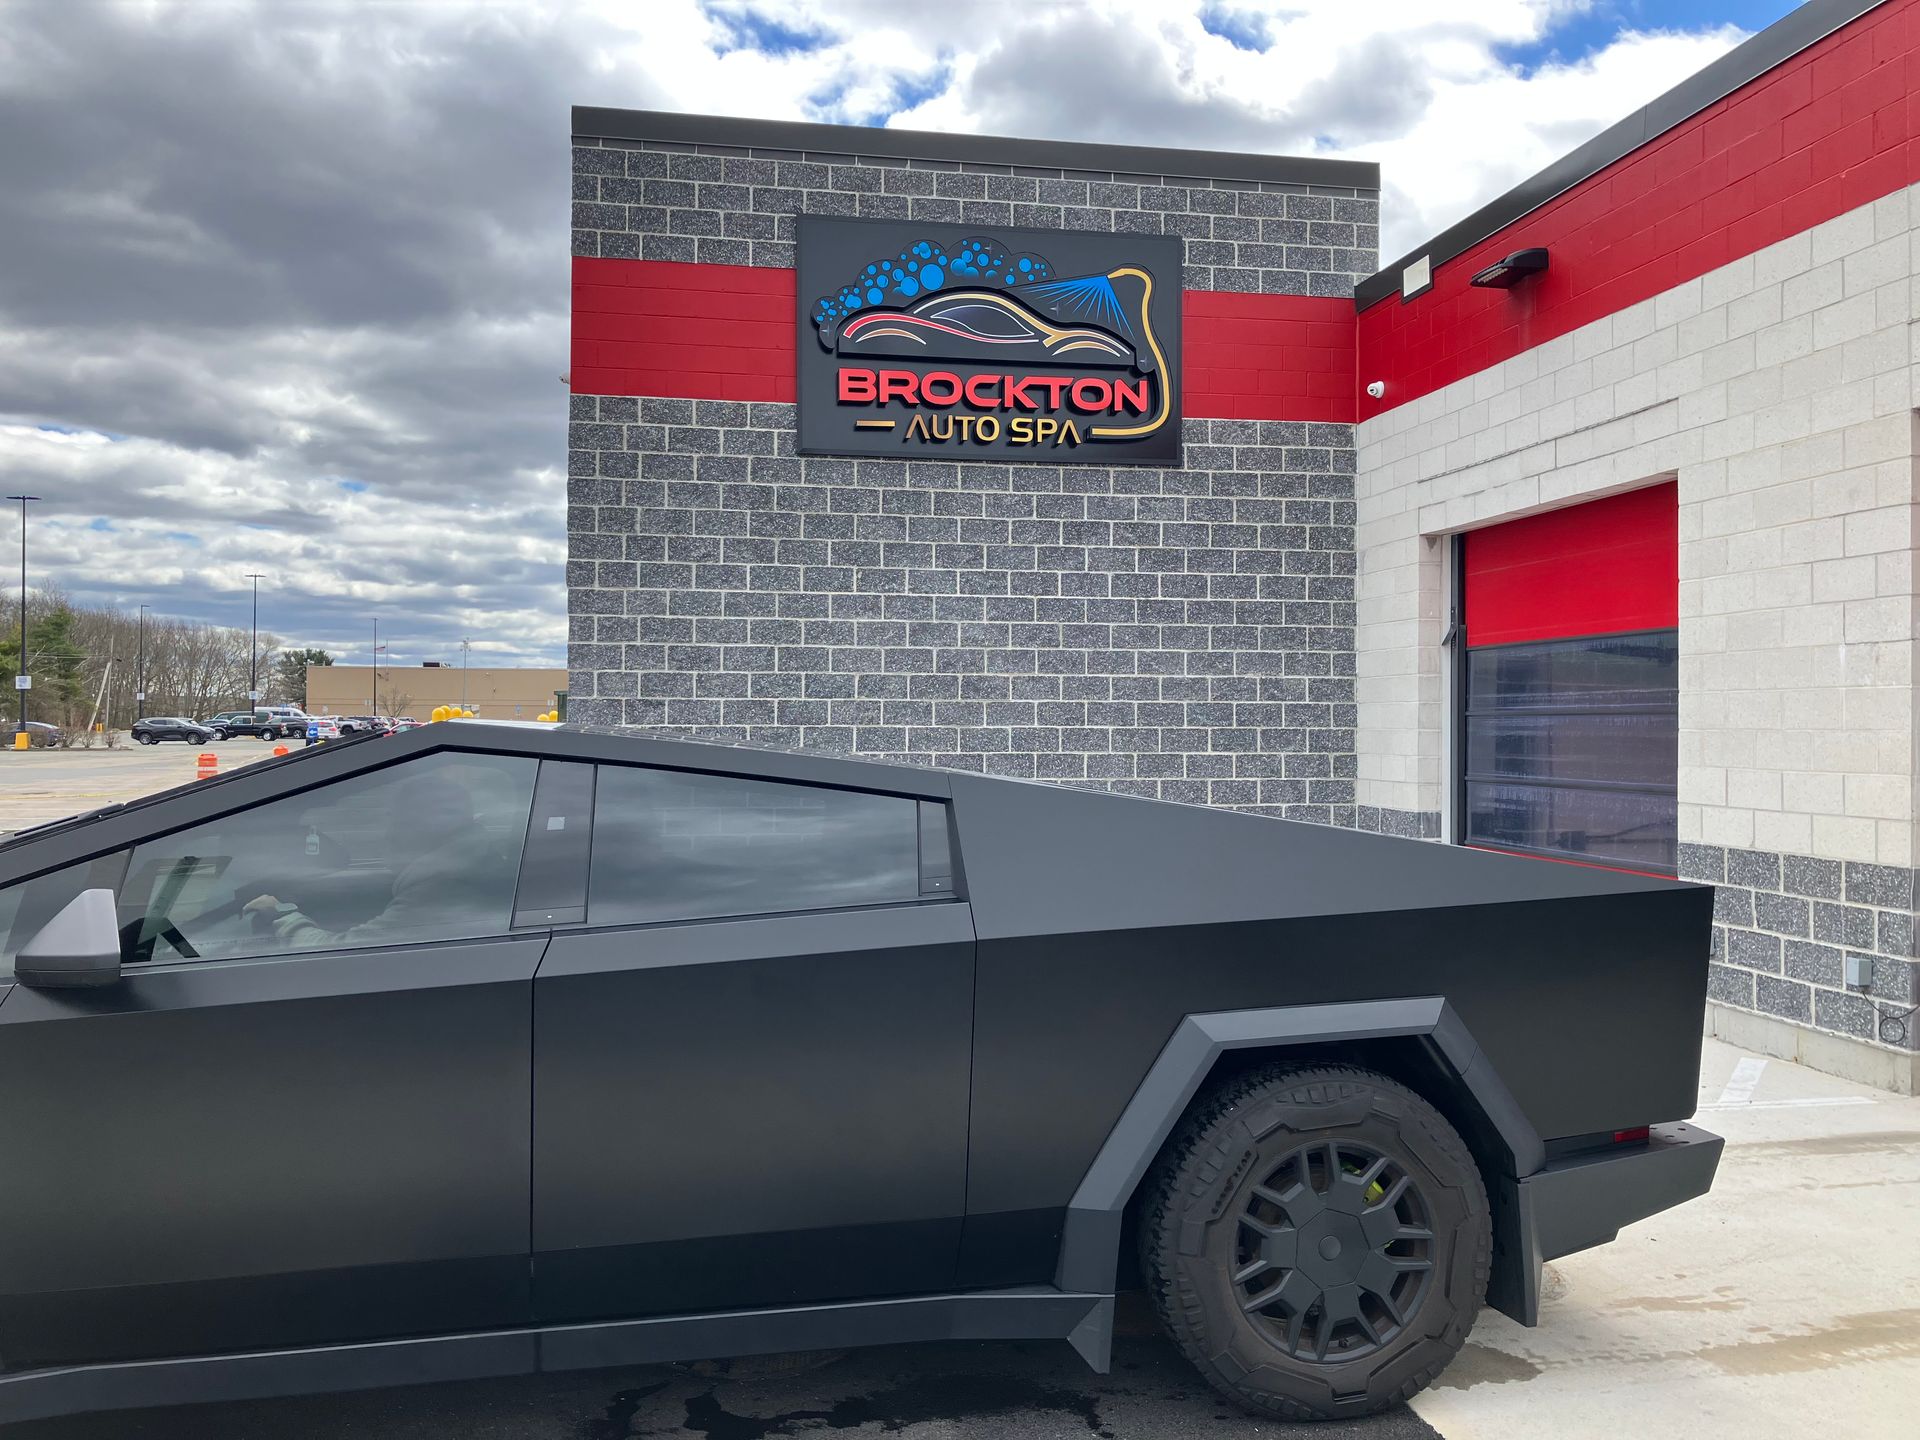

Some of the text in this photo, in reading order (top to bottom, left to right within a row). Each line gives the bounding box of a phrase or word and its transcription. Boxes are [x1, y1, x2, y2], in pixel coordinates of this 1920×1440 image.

[838, 367, 1149, 413] BROCKTON
[904, 413, 1083, 446] AUTO SPA
